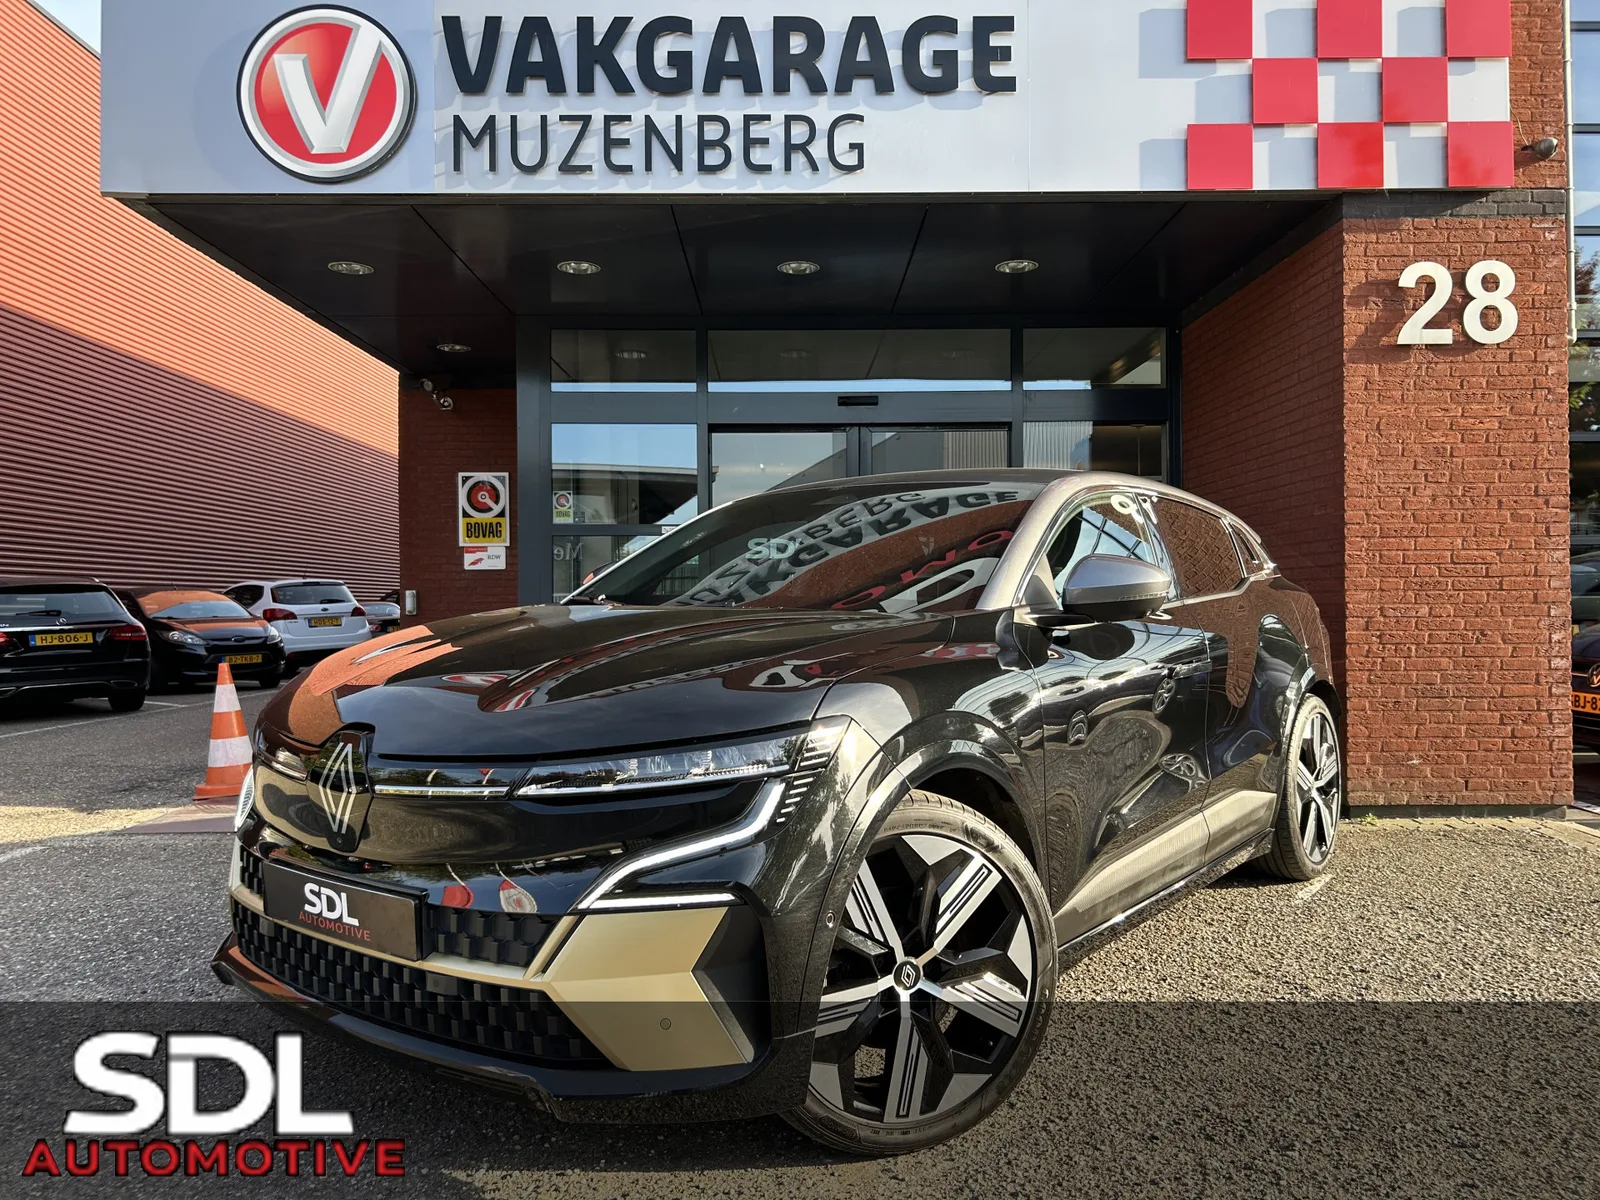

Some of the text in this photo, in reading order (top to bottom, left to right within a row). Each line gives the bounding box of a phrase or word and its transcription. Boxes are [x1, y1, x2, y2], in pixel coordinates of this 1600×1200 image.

[441, 15, 1017, 95] VAKGARAGE
[453, 113, 865, 173] MUZENBERG
[1397, 260, 1518, 344] 28
[466, 522, 502, 539] BOVAG
[40, 634, 89, 644] HJ-806-J
[228, 655, 260, 663] 82-TKB-7
[1571, 693, 1600, 711] BJ-8
[304, 882, 359, 926] SDL
[299, 911, 371, 942] AUTOMOTIVE
